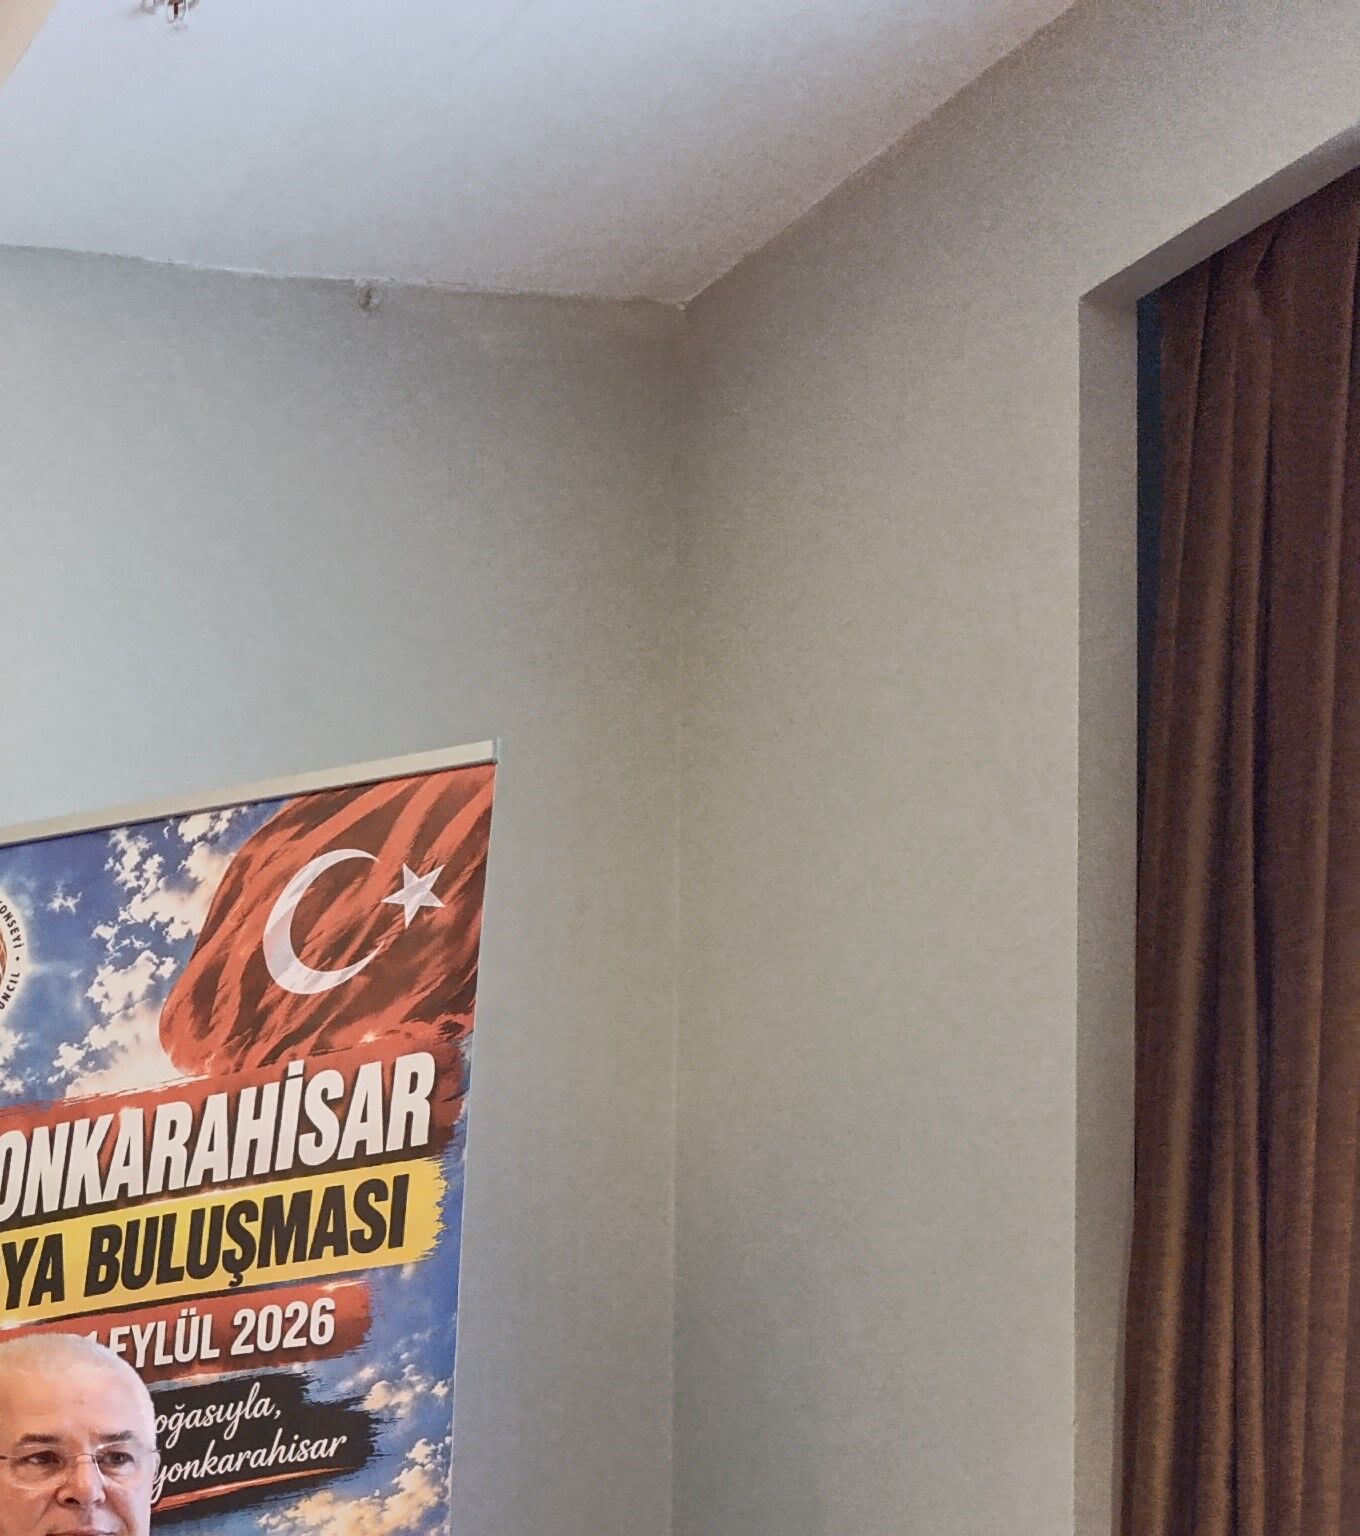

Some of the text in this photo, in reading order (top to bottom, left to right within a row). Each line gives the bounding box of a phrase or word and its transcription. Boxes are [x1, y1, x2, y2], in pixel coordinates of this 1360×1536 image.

[84, 1174, 410, 1298] BULUŞMASI
[108, 1296, 335, 1369] EYLÜL 2026
[155, 1381, 282, 1450] oğasıyla,
[150, 1427, 348, 1504] yonkarahisar
